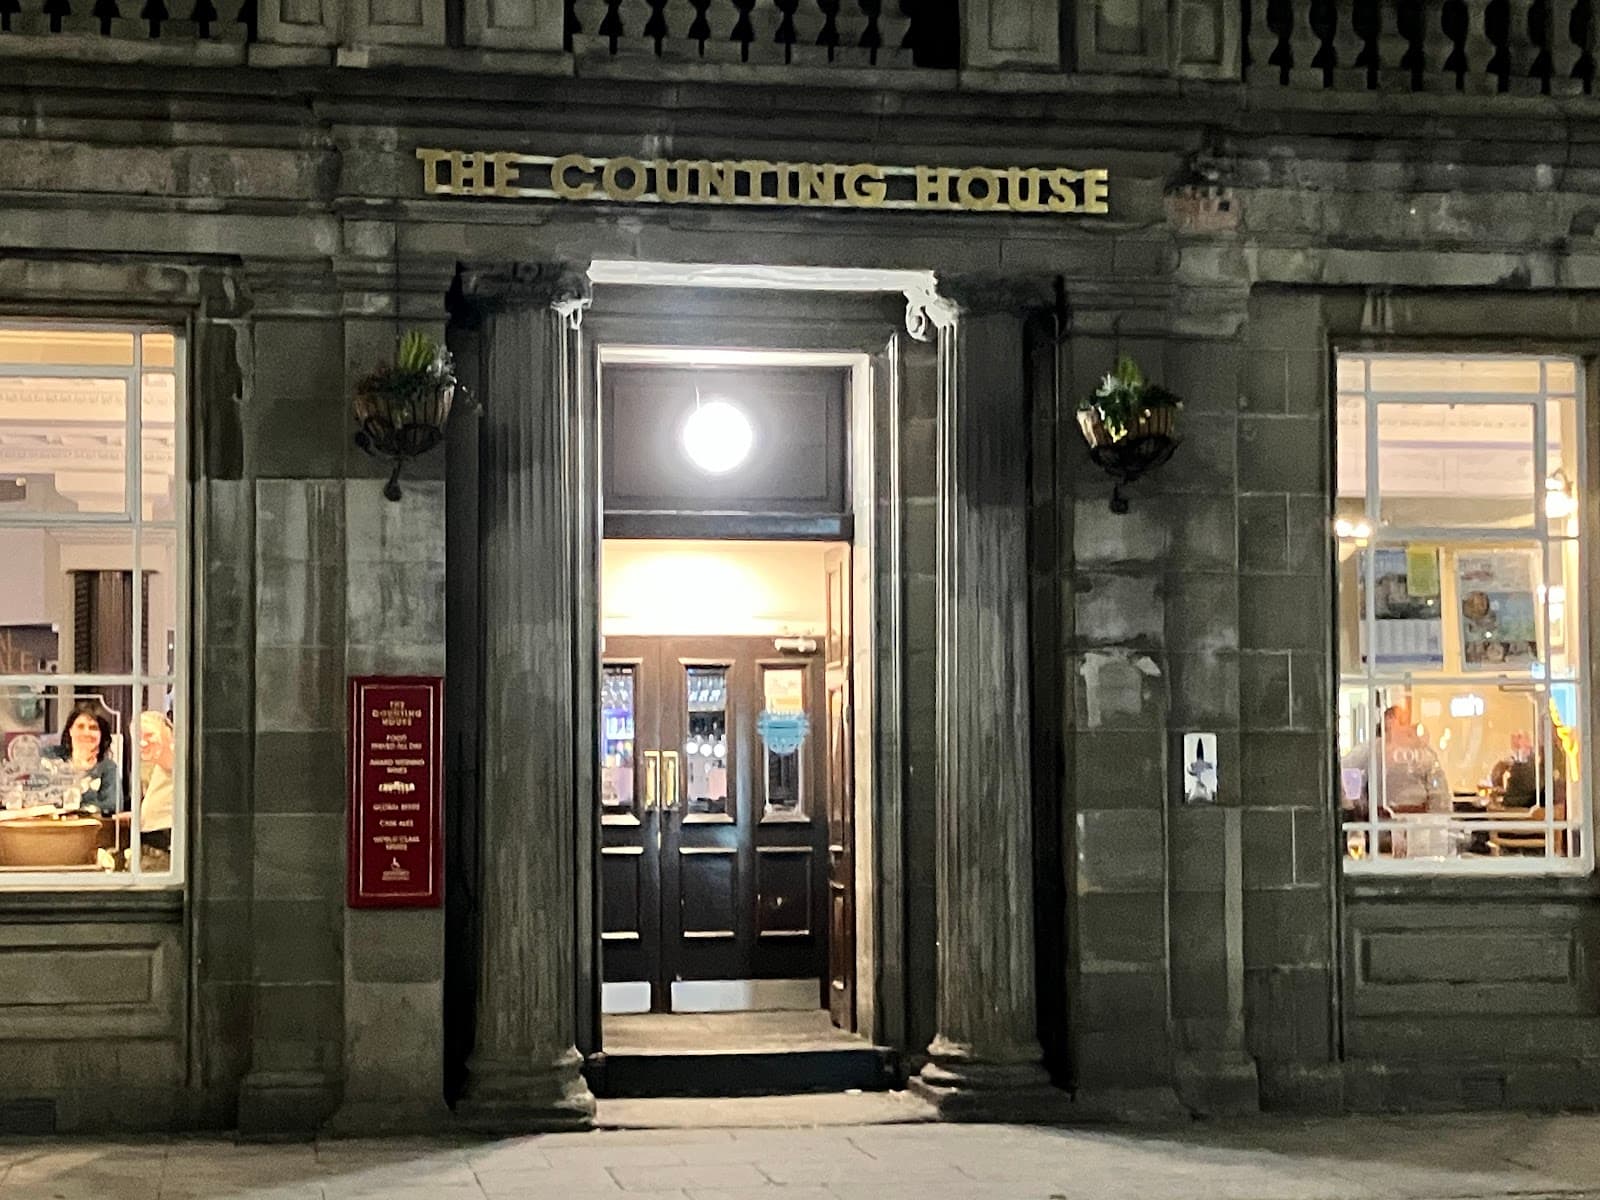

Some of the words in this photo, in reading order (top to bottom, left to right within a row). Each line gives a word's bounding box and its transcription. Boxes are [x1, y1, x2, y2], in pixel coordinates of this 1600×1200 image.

[416, 148, 520, 198] THE
[551, 153, 887, 208] COUNTING
[916, 165, 1109, 214] HOUSE
[372, 709, 422, 718] COUNTING
[382, 718, 412, 726] HOUSE
